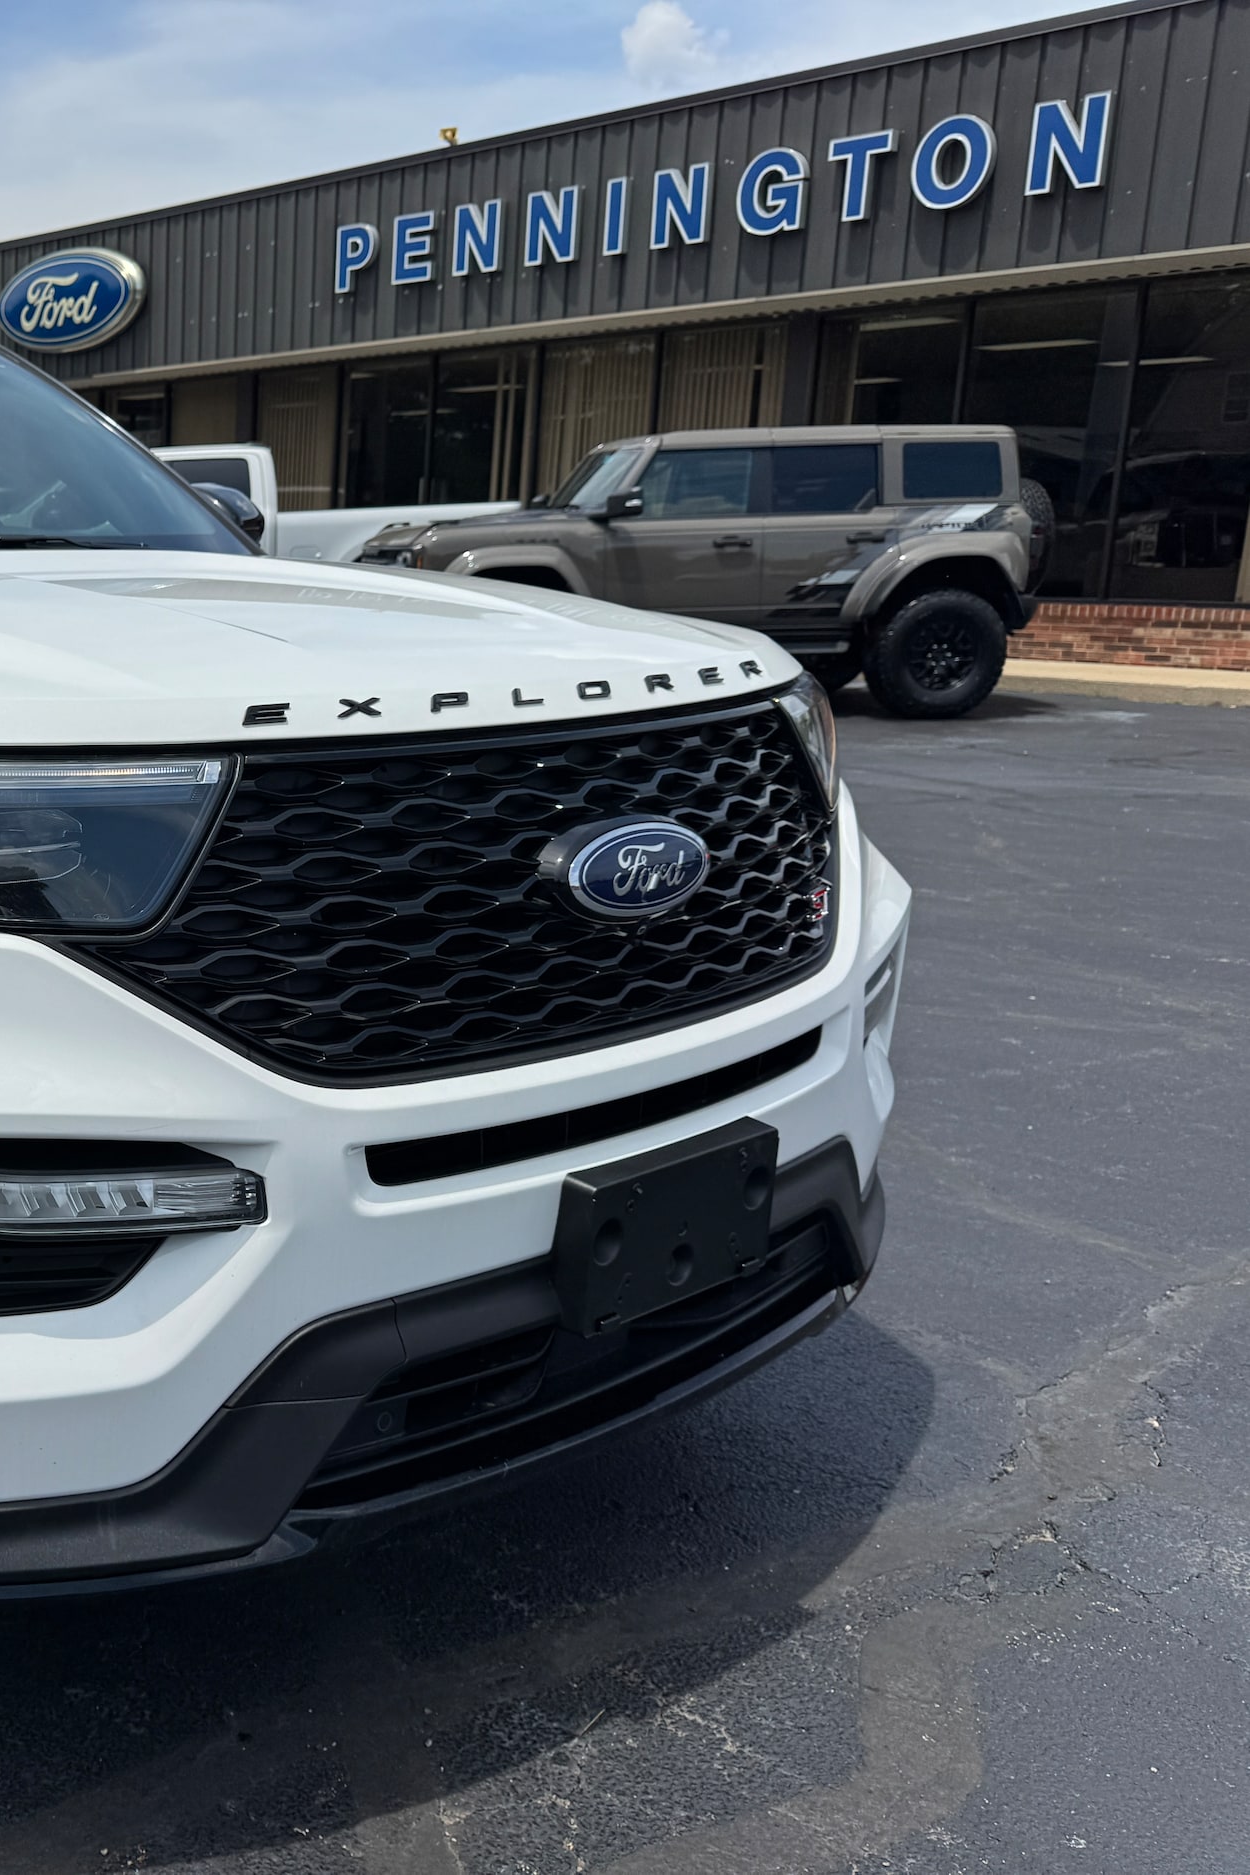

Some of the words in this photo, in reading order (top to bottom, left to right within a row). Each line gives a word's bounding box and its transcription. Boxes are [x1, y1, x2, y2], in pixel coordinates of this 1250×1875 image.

[333, 89, 1114, 295] PENNINGTON
[19, 271, 100, 333] Ford
[241, 659, 763, 727] EXPLORER
[613, 842, 686, 896] Ford
